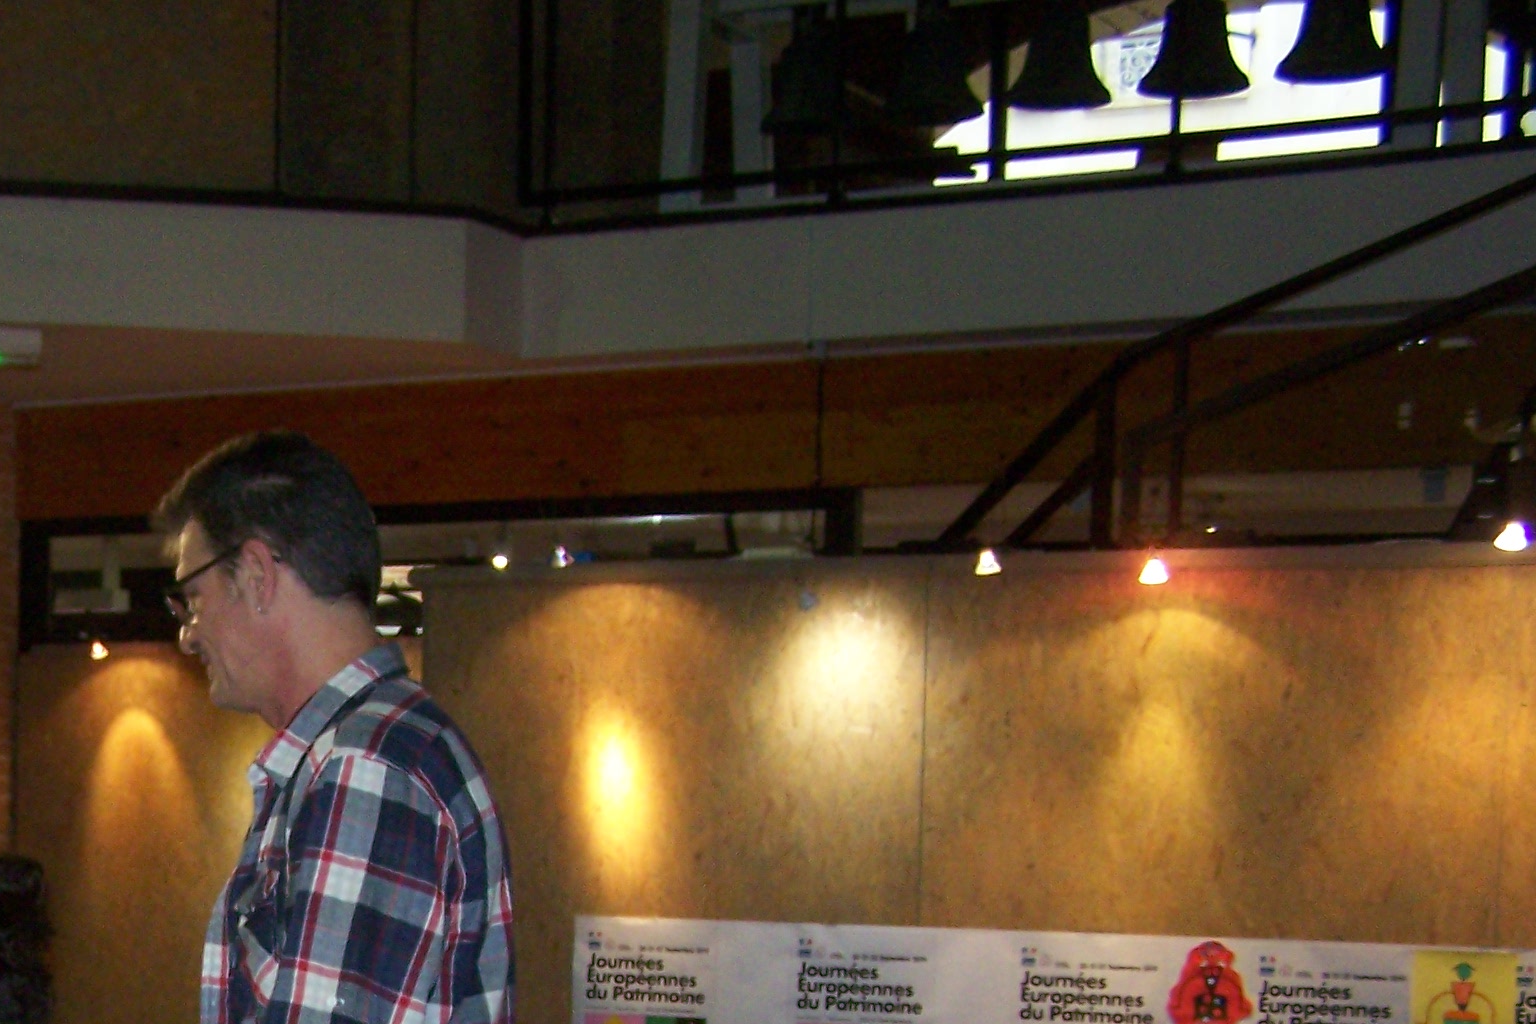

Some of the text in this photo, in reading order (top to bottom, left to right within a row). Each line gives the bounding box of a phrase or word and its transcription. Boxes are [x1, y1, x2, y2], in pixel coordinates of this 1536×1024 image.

[588, 952, 664, 971] Journées
[798, 962, 879, 980] Journées
[587, 967, 697, 989] Européennes
[798, 977, 914, 997] Européennes
[1021, 971, 1107, 989] Journées
[586, 984, 705, 1005] du Patrimoine
[1021, 987, 1144, 1008] Européennes
[1259, 981, 1351, 1000] Journées
[797, 994, 923, 1015] du Patrimoine
[1020, 1004, 1154, 1024] du Patrimoine
[1259, 997, 1391, 1019] Européennes
